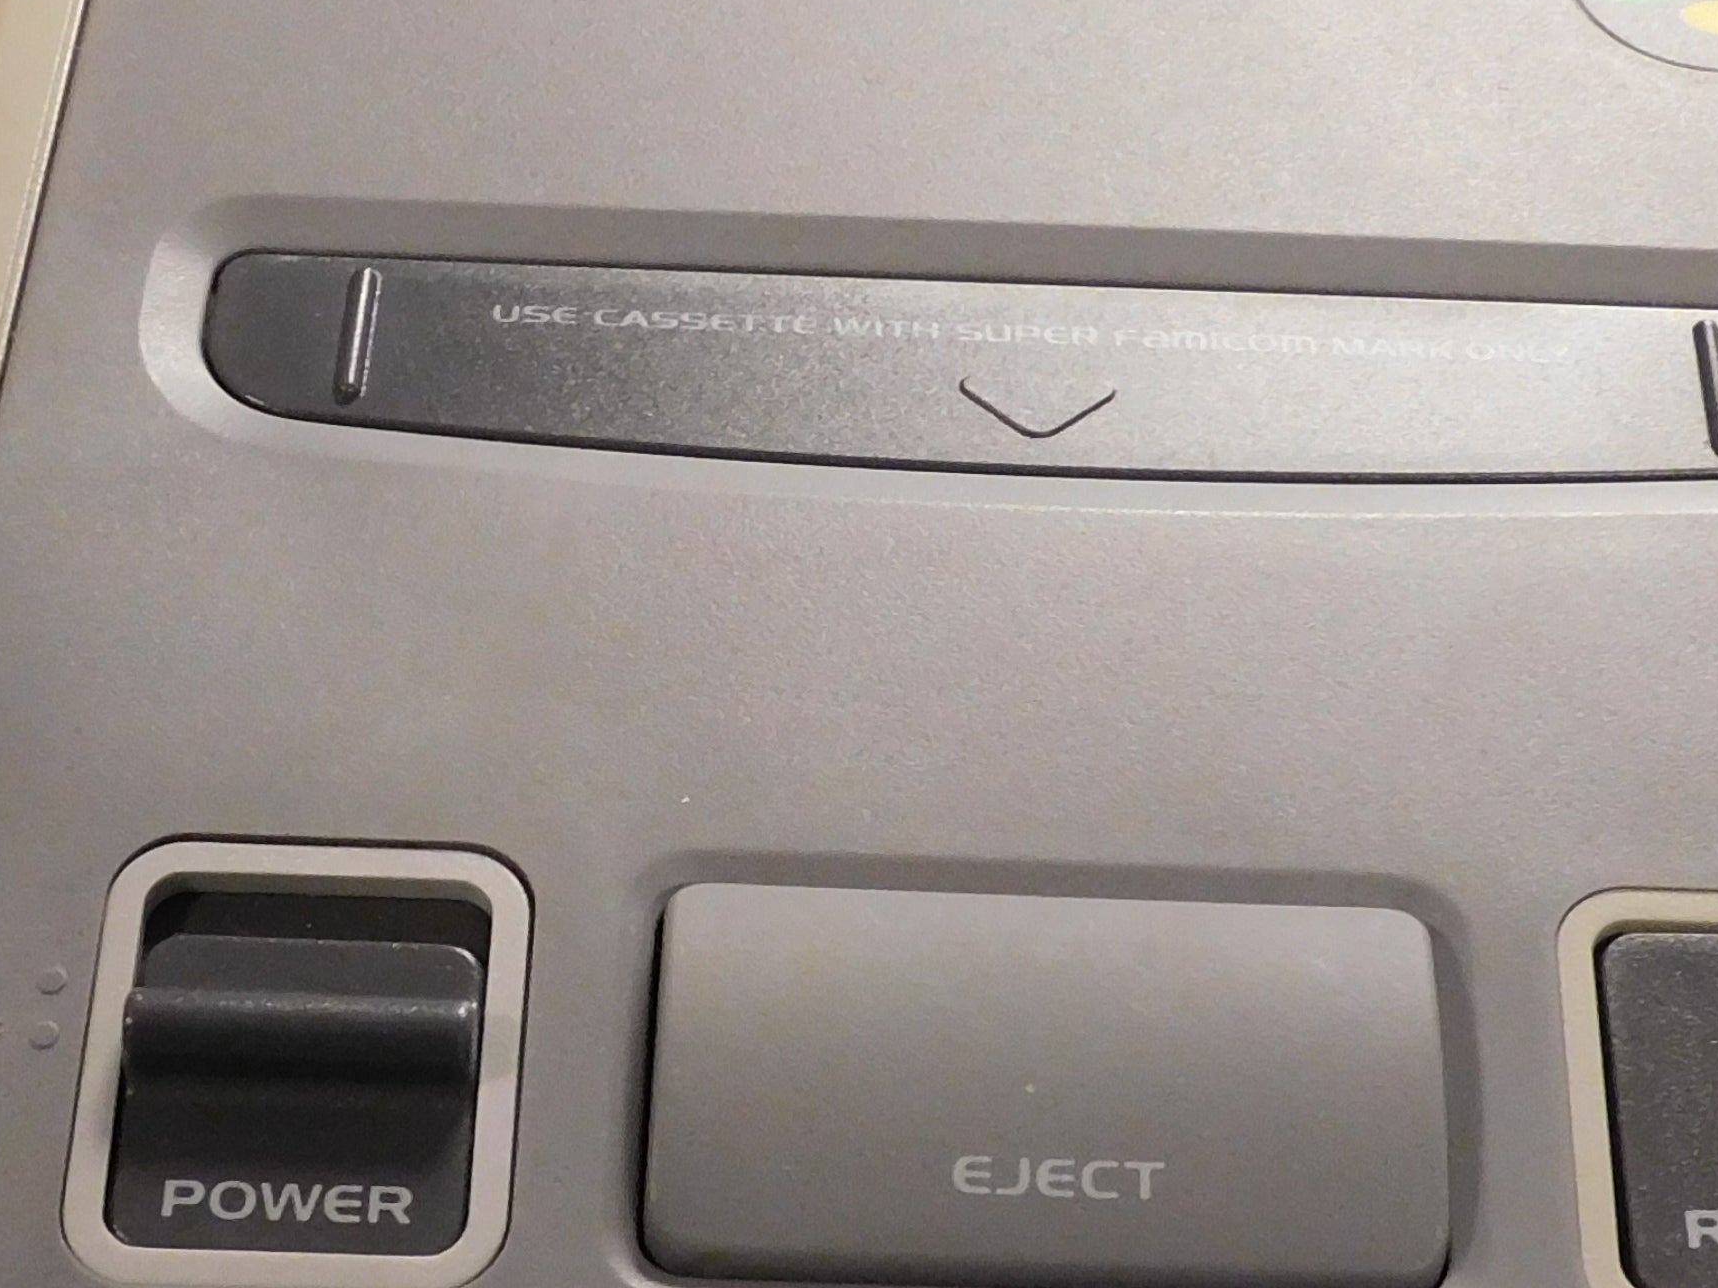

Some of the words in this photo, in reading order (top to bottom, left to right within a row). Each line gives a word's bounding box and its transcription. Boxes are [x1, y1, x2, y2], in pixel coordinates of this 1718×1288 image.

[492, 303, 578, 325] USE
[592, 307, 817, 336] CASSETTE
[834, 316, 940, 341] WITH
[958, 320, 1098, 346] SUPER
[951, 1154, 1166, 1201] EJECT
[160, 1178, 415, 1226] POWER
